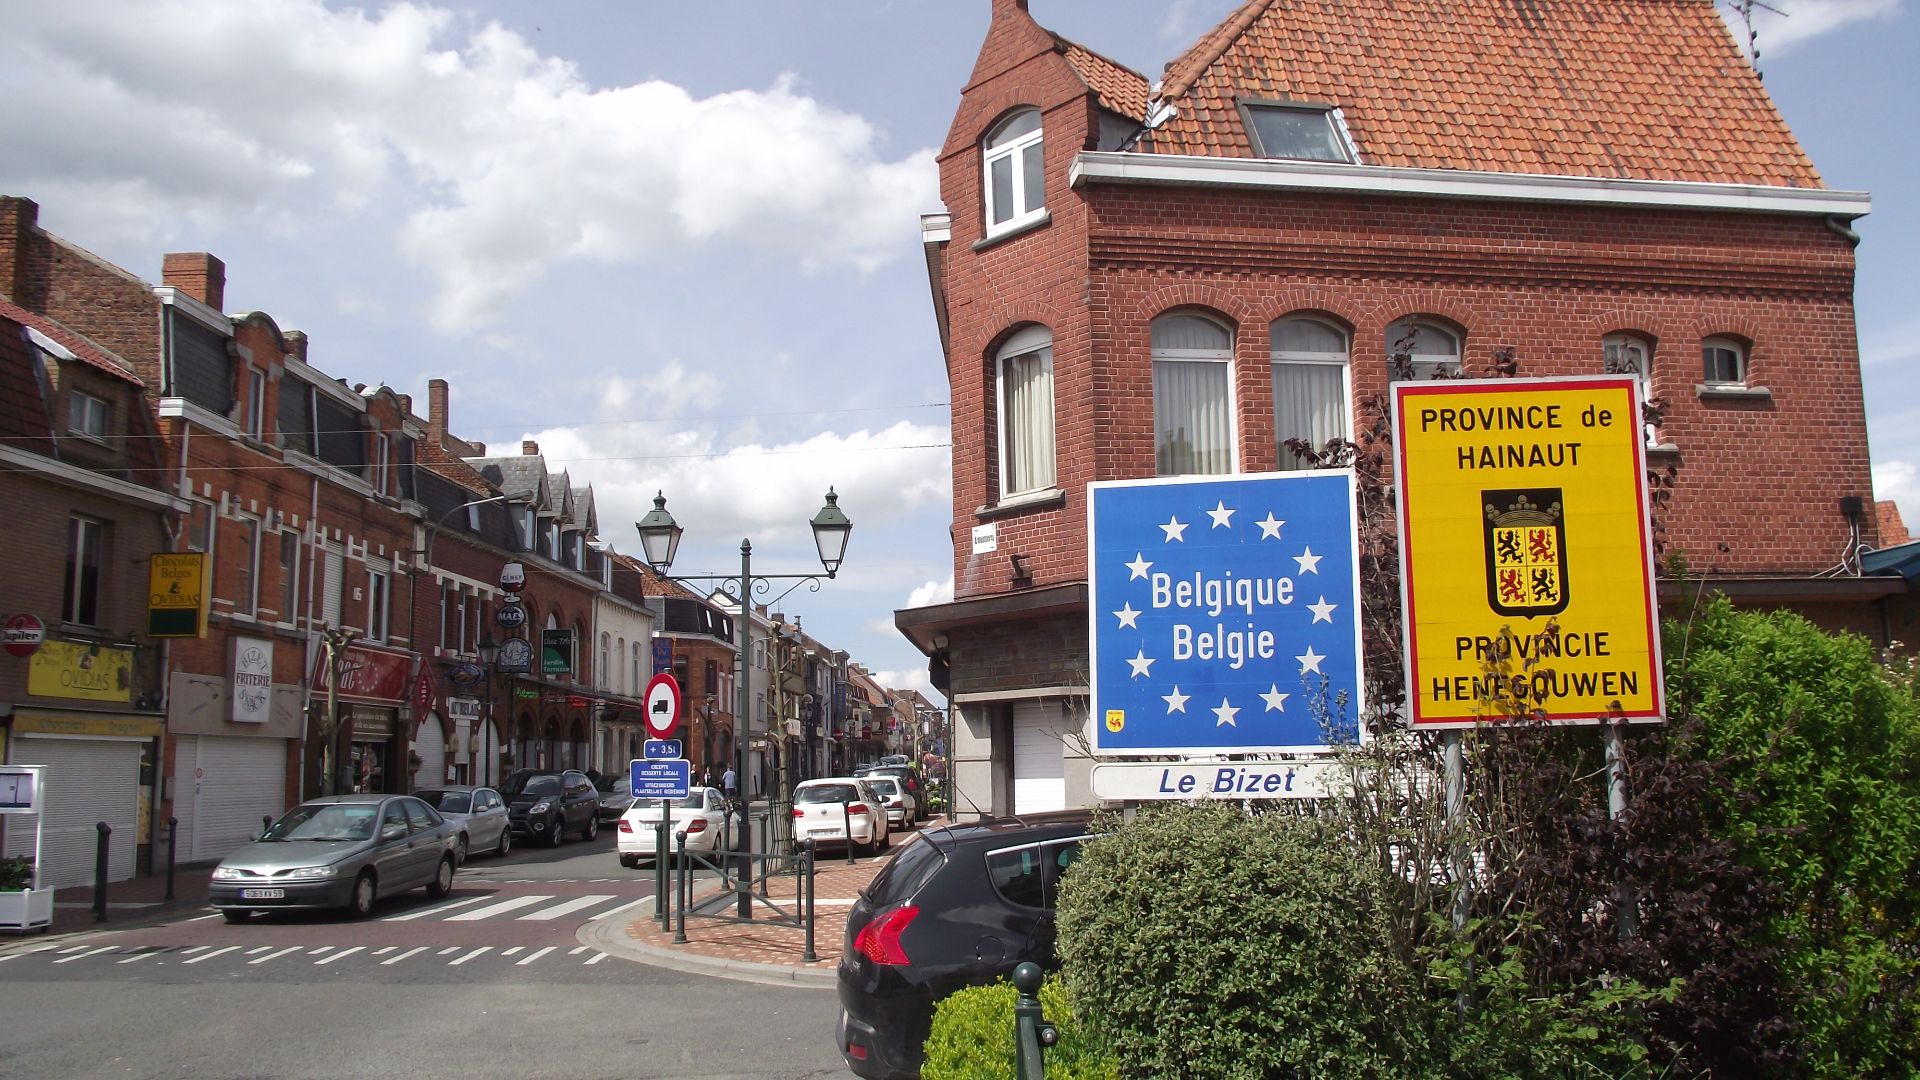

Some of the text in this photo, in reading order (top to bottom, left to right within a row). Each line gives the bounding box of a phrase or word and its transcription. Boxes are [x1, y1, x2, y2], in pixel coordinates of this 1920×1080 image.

[1421, 404, 1622, 432] PROVINCE de
[1467, 442, 1591, 469] HAINAUT
[153, 555, 200, 567] Chocolats
[161, 567, 191, 579] Belges
[1152, 571, 1294, 617] Belgique
[498, 611, 524, 621] MAES
[2, 631, 39, 642] Jupiler
[1173, 622, 1275, 669] Belgie
[1456, 632, 1611, 661] PROVINCIE
[61, 669, 110, 690] OVIDIAS
[236, 672, 270, 687] FRITERIE
[1433, 671, 1638, 701] HENEGOUWEN
[1159, 767, 1296, 793] Le Bizet
